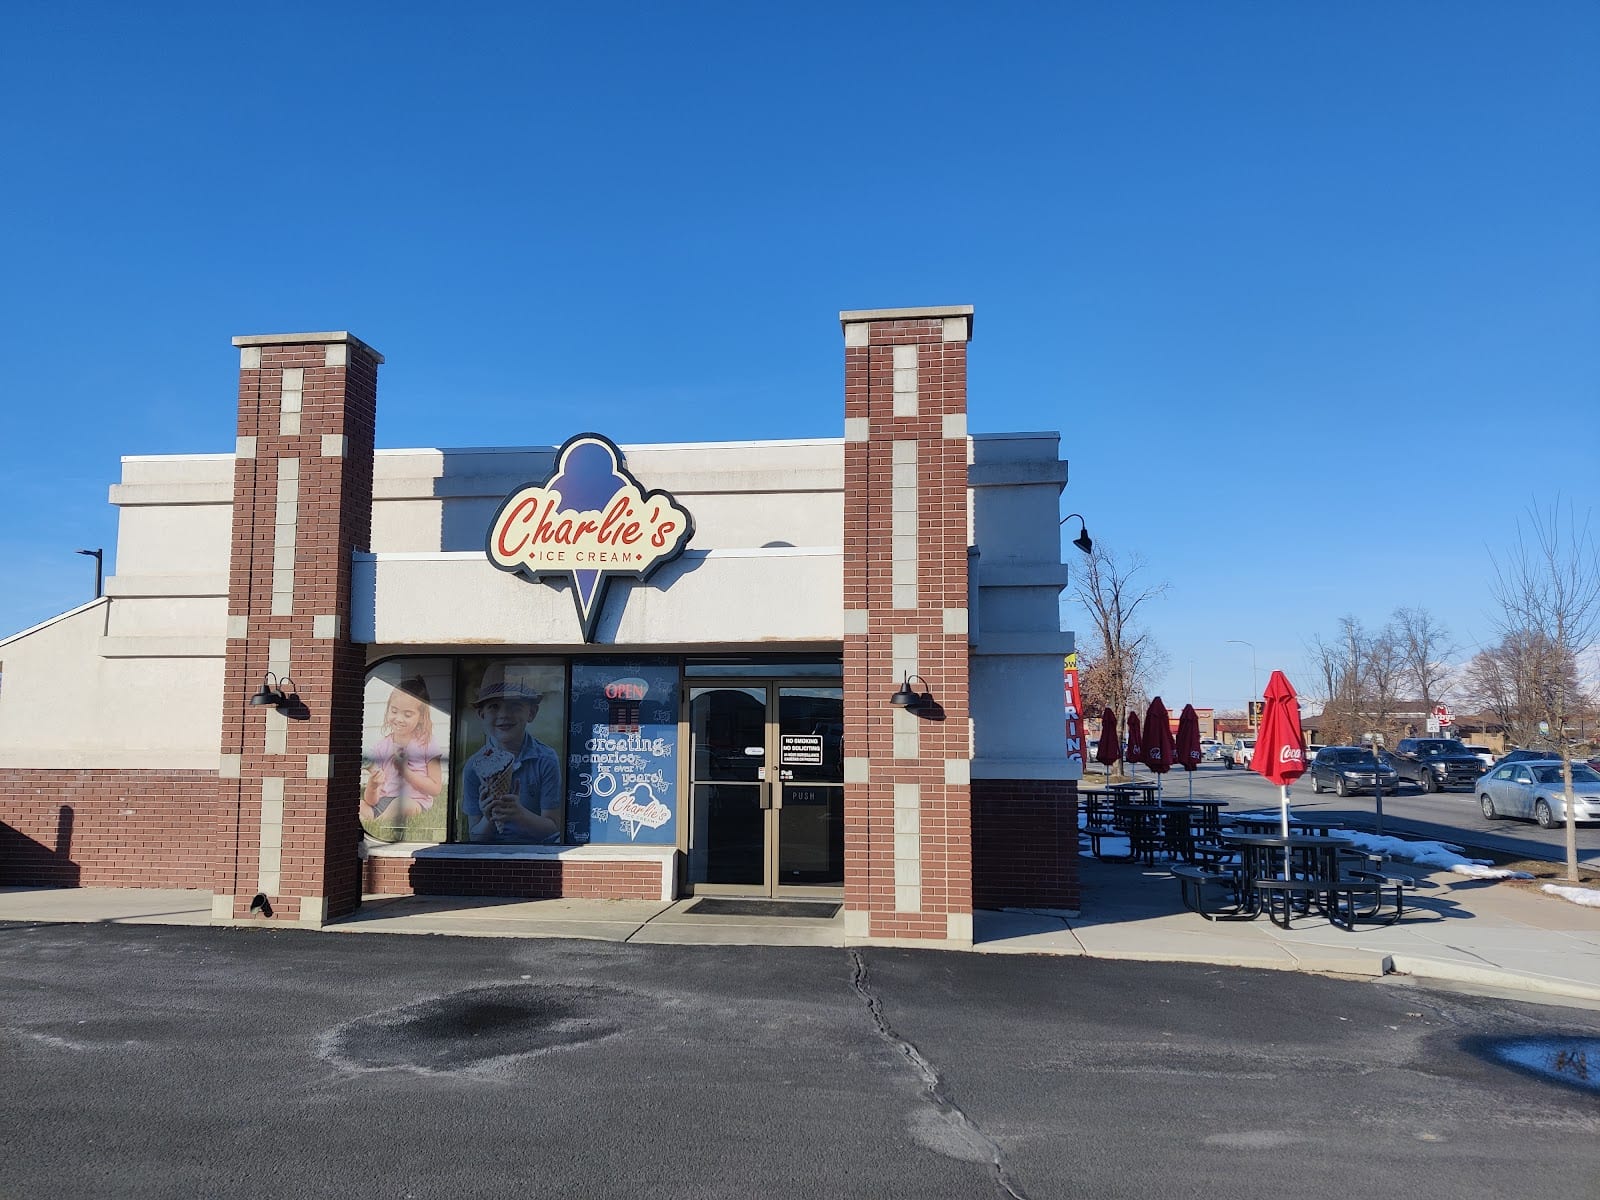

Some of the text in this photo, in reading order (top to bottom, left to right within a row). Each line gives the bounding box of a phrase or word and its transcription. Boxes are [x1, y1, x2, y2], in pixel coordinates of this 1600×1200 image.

[498, 497, 676, 556] Charlie's
[539, 551, 632, 562] ICE CREAM
[605, 683, 644, 699] OPEN
[585, 738, 664, 756] creating
[570, 752, 635, 764] memories
[614, 765, 634, 773] over
[576, 772, 617, 797] 30
[792, 791, 815, 800] PUSH
[612, 795, 668, 821] Charlie's
